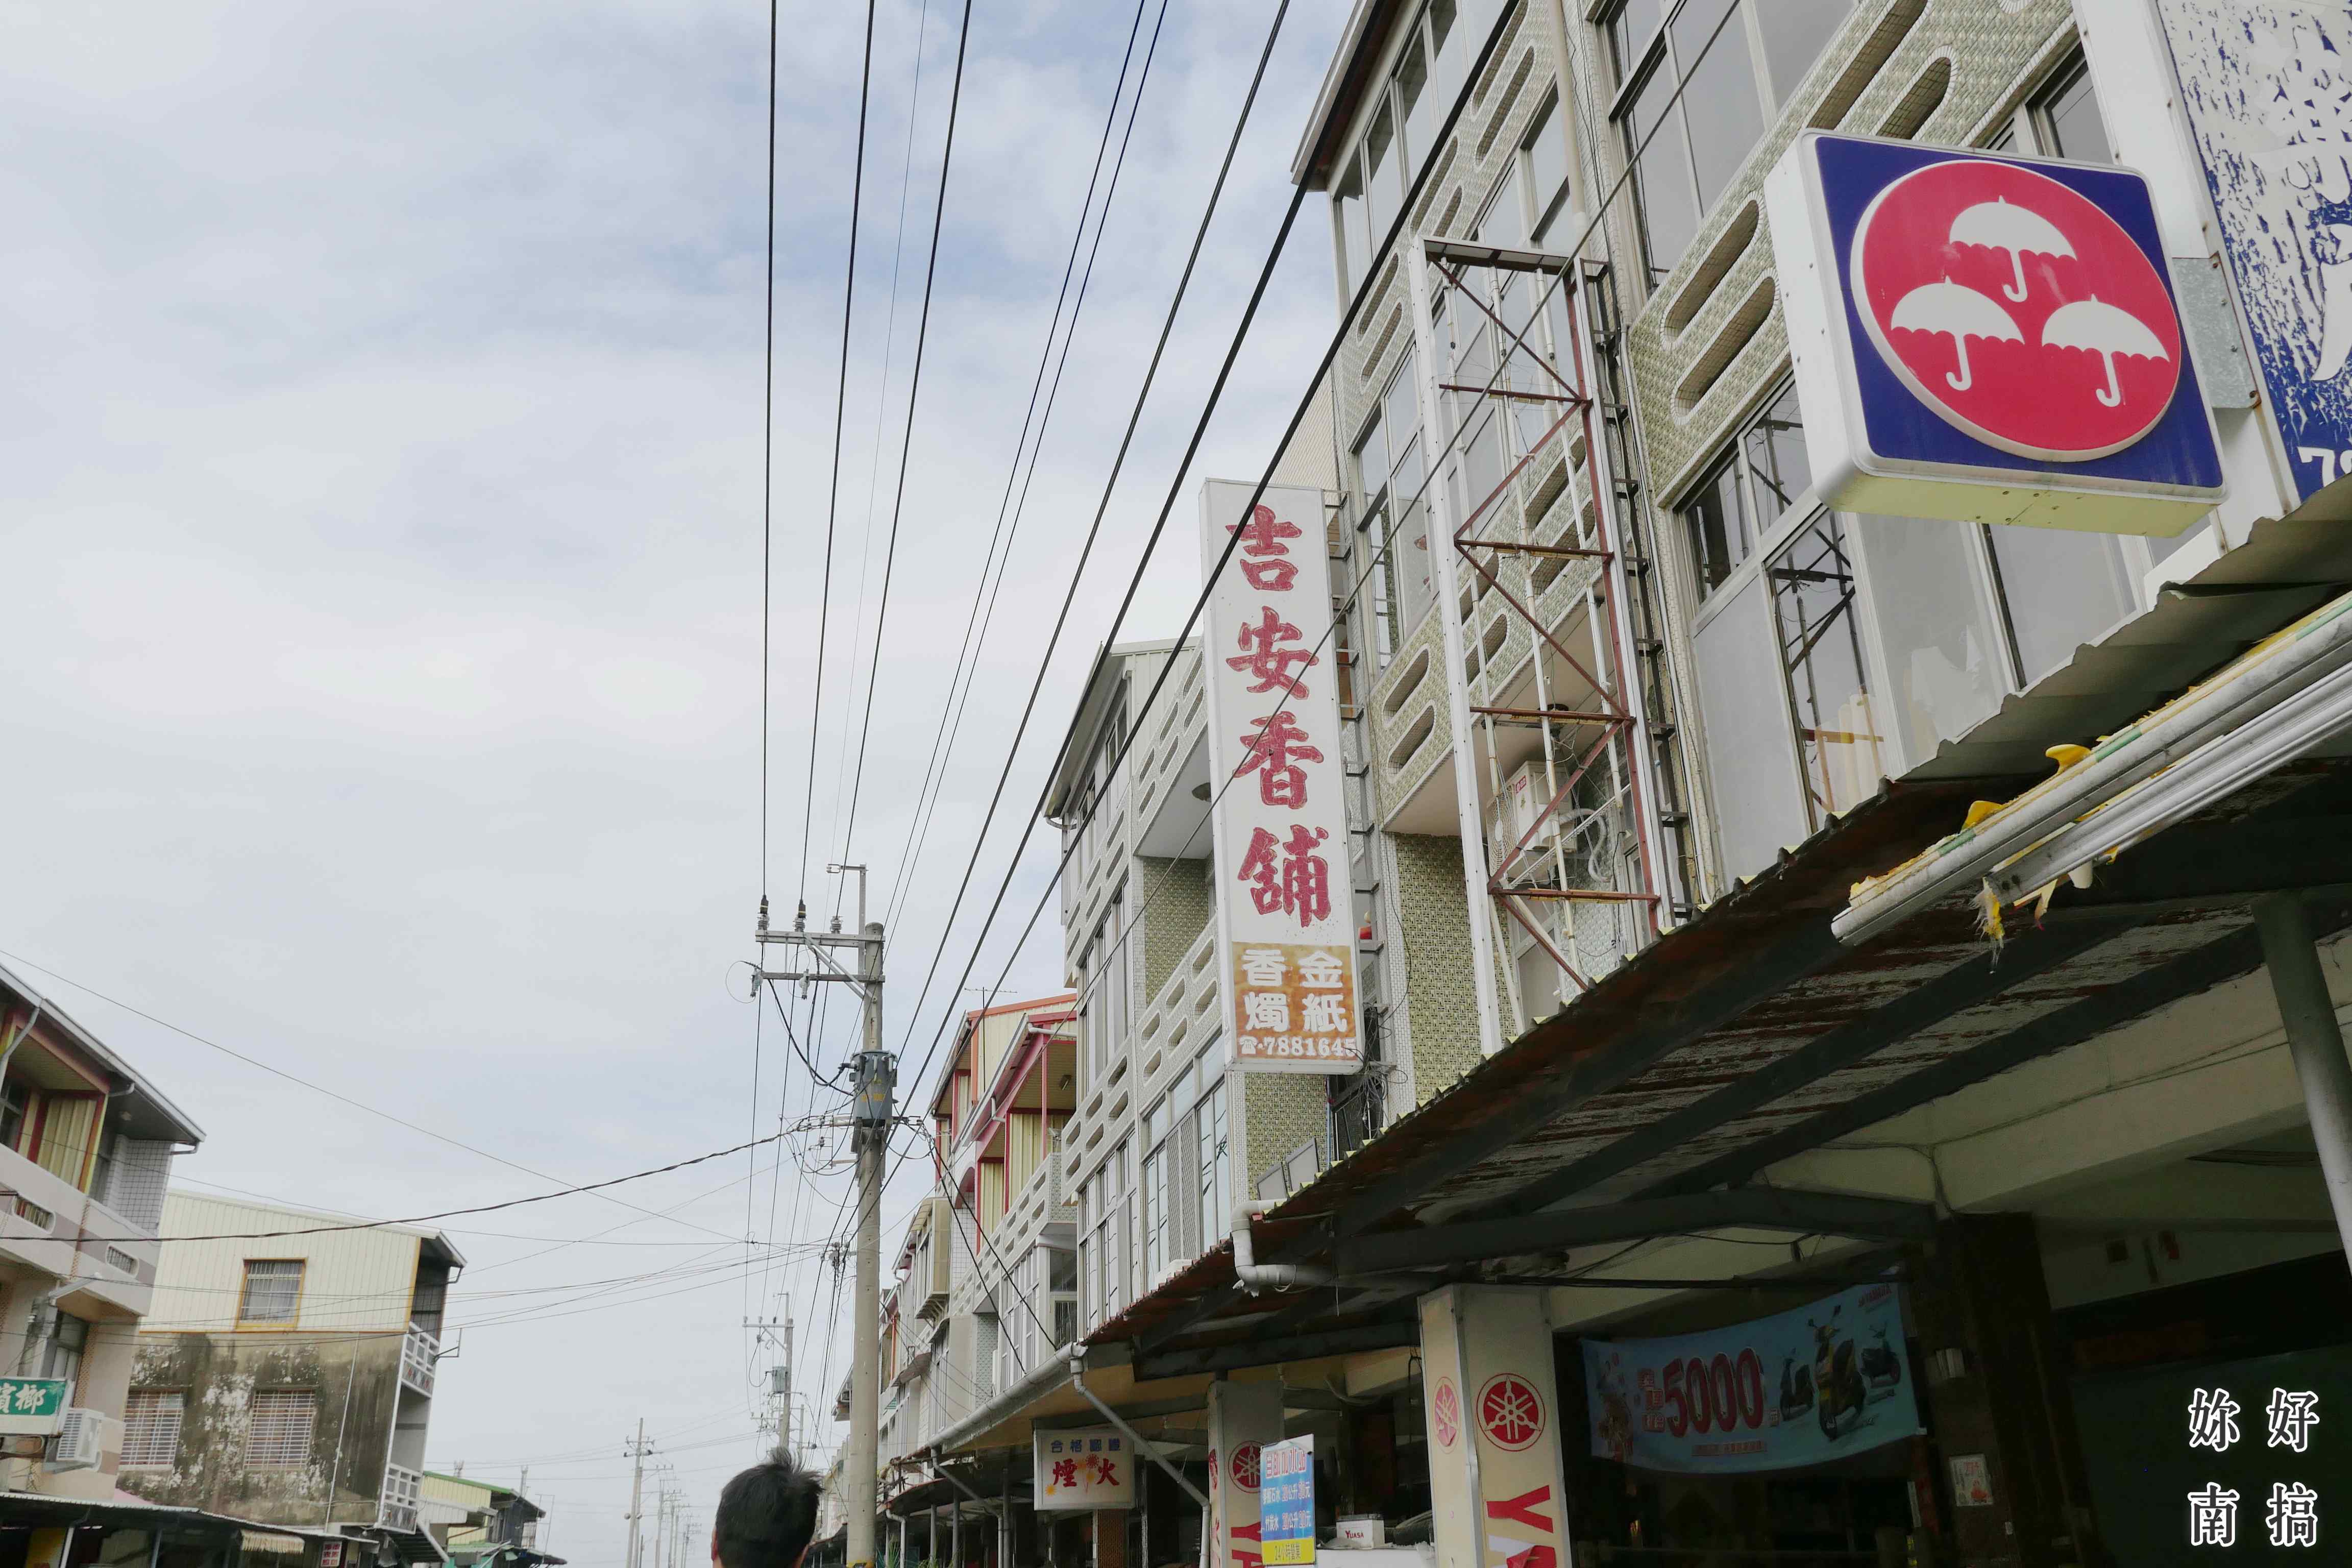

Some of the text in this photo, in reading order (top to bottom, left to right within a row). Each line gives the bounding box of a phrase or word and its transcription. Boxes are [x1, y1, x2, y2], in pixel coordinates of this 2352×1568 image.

[2296, 447, 2352, 487] 7
[1226, 504, 1333, 928] 吉安香舖
[1662, 1346, 1765, 1438] 5000
[1052, 1458, 1120, 1488] 煙火
[1345, 1530, 1364, 1539] YUASA
